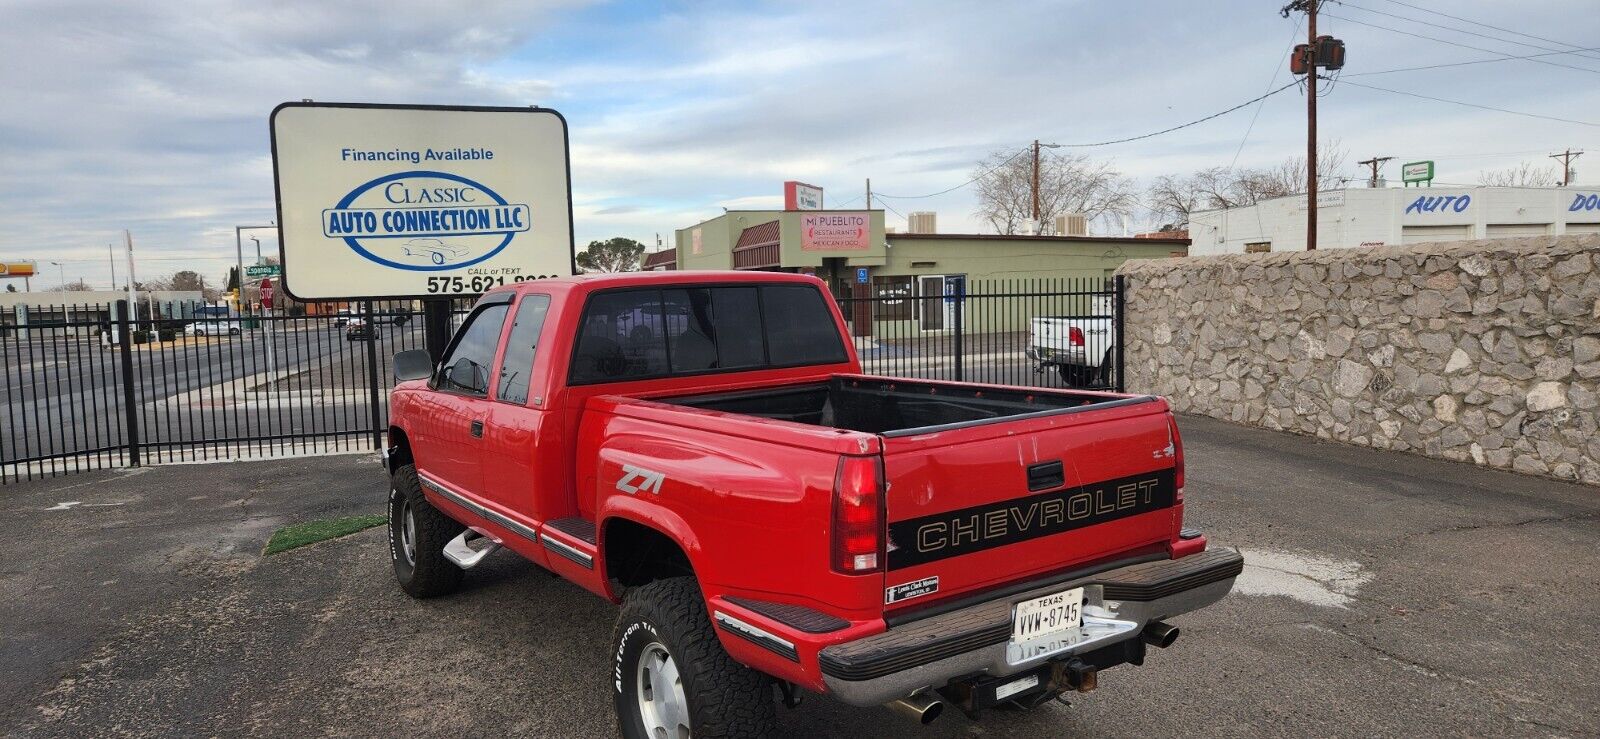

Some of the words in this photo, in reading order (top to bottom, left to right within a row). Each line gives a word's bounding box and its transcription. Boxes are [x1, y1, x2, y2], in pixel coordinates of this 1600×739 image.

[341, 148, 420, 164] Financing
[424, 147, 494, 161] Available
[1405, 194, 1471, 215] AUTO
[1568, 193, 1600, 211] DO
[329, 211, 377, 233] AUTO
[382, 209, 490, 232] CONNECTION
[495, 207, 522, 229] LLC
[806, 218, 817, 226] MI
[820, 216, 864, 226] PUEBLITO
[261, 288, 273, 299] STOP
[616, 463, 666, 495] Z71
[917, 479, 1159, 552] CHEVROLET
[1039, 595, 1064, 608] TEXAS
[615, 622, 640, 694] All-Terrain
